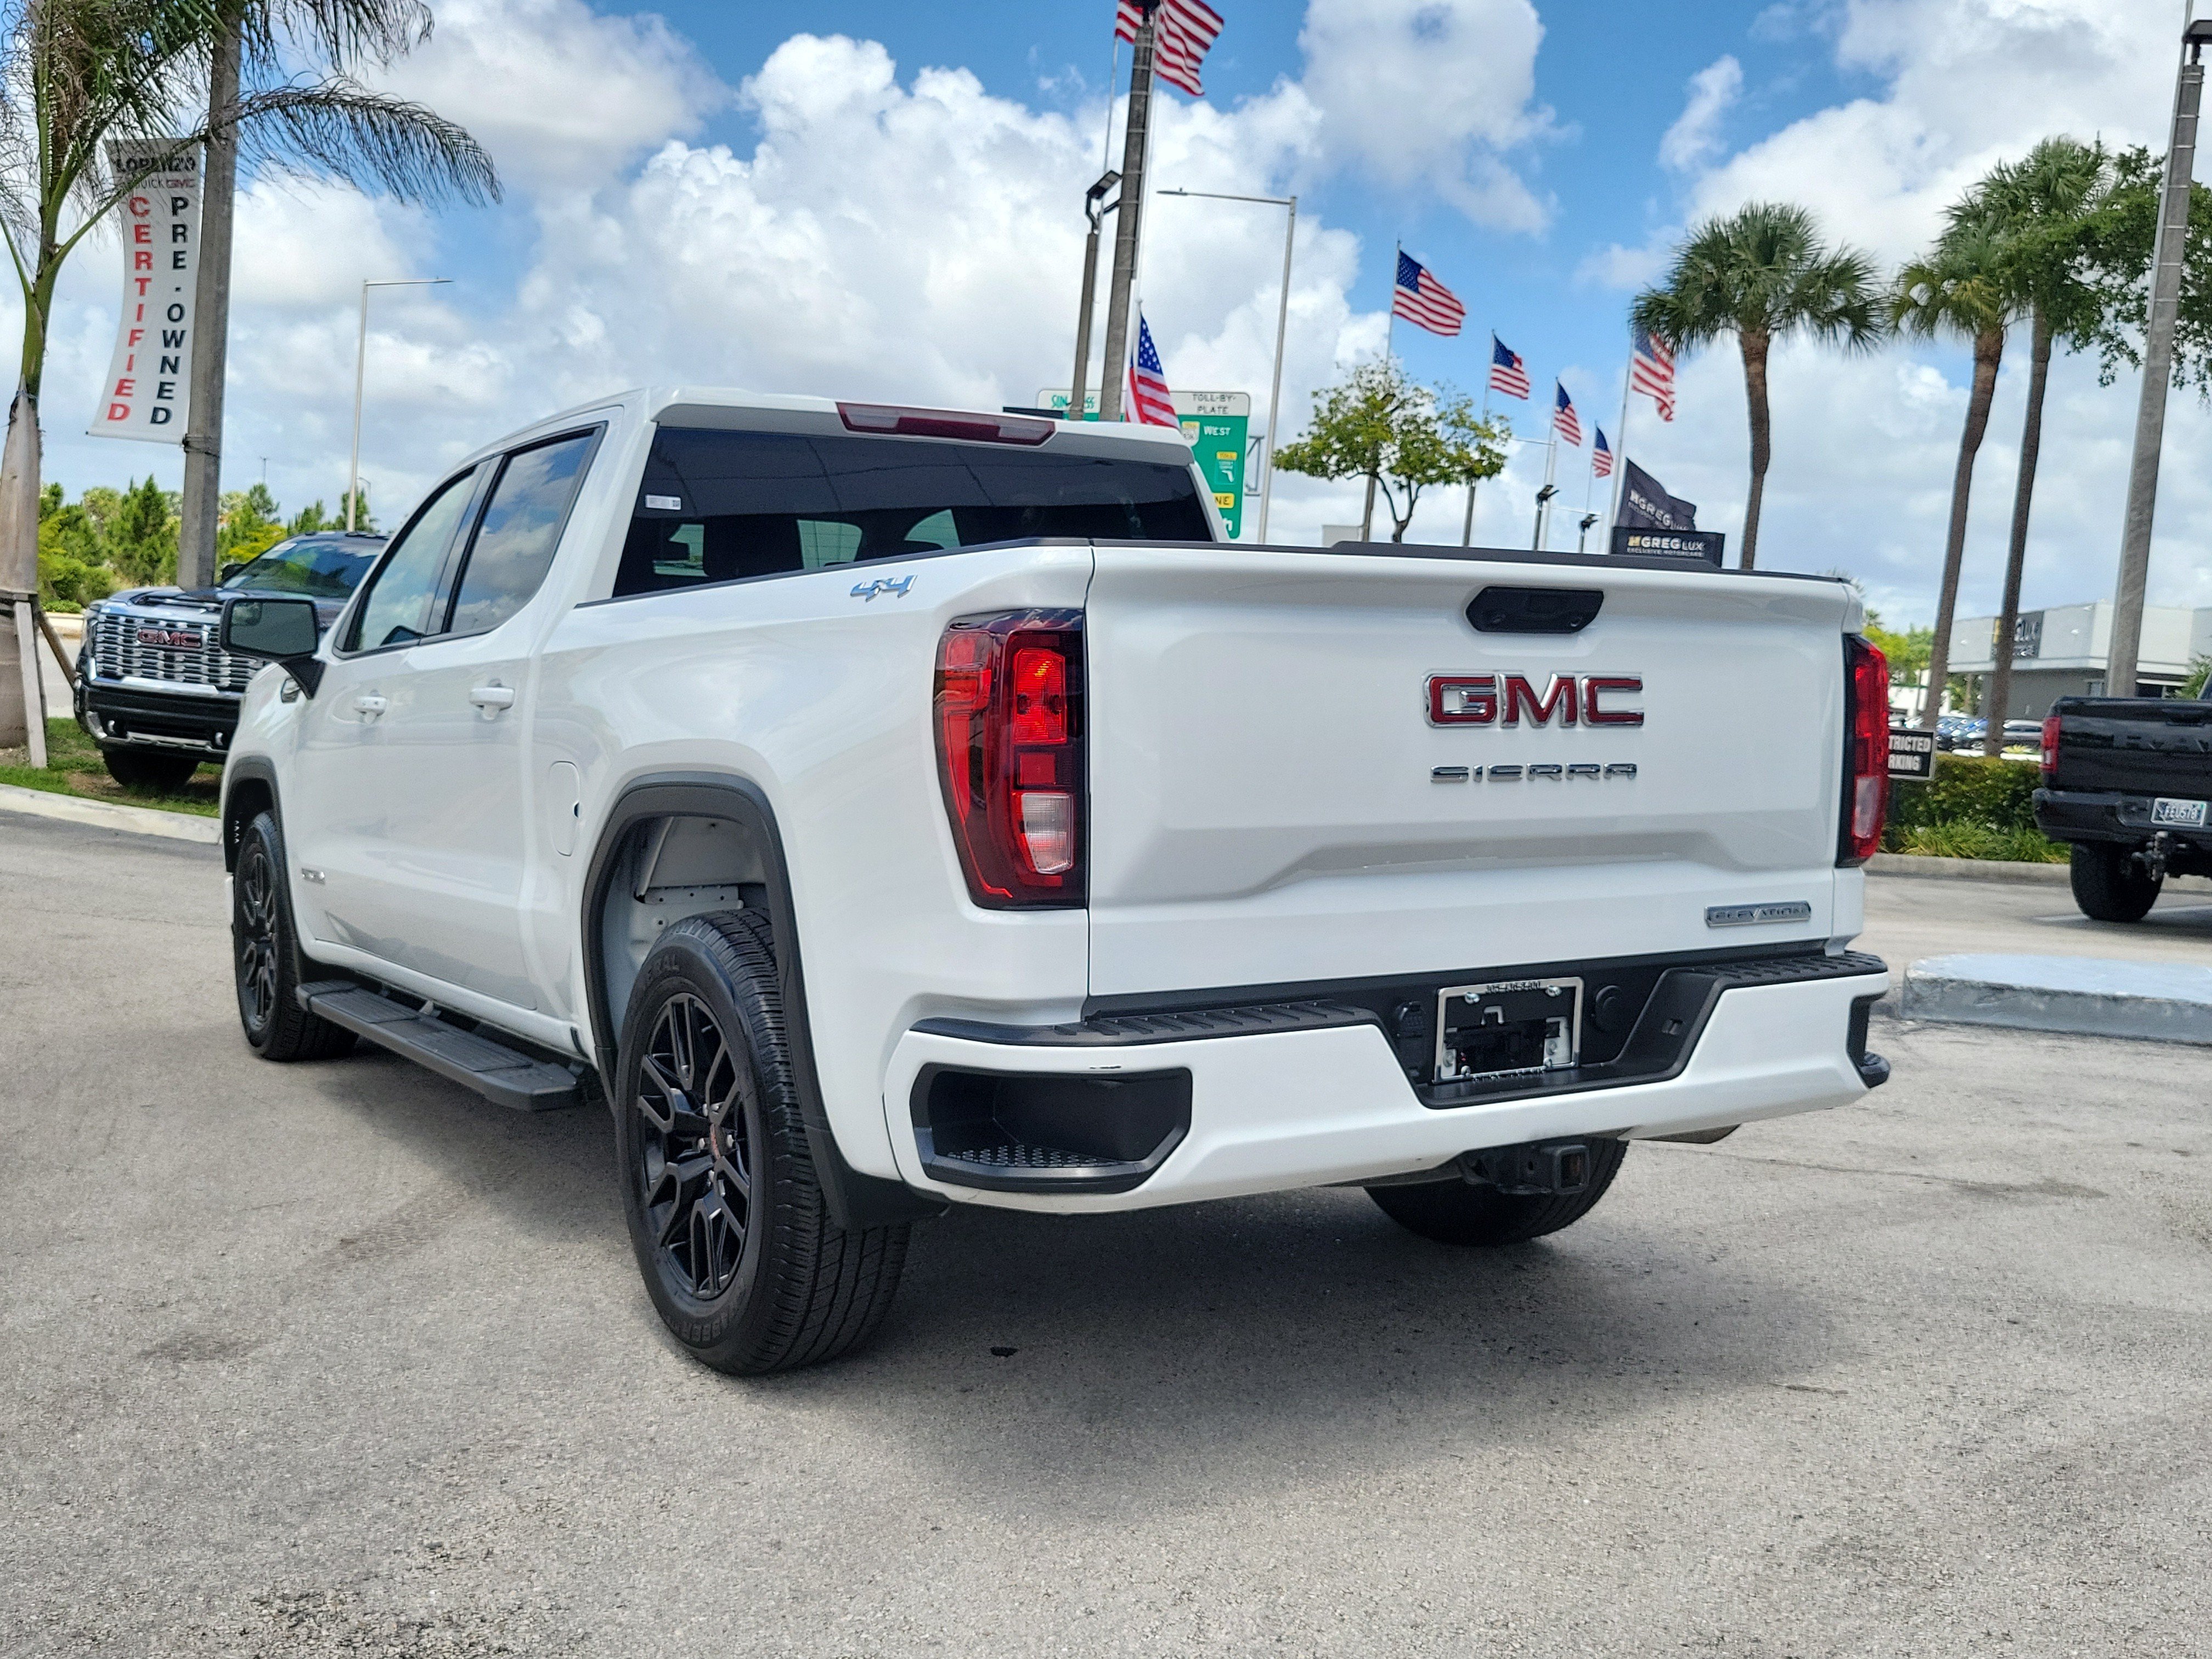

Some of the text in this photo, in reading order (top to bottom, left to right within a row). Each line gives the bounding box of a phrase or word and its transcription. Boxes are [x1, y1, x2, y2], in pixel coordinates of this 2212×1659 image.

[166, 179, 196, 189] GMC
[108, 196, 153, 421] CERTIFIED
[1197, 405, 1229, 414] PLATE
[1203, 425, 1231, 436] WEST
[1682, 540, 1706, 551] LUX
[138, 629, 201, 647] GMC
[1423, 671, 1644, 729] GMC
[1888, 735, 1932, 753] TRICTED
[1888, 753, 1921, 771] RKING
[1430, 763, 1637, 783] SIERRA
[1712, 905, 1806, 920] ELEVATION
